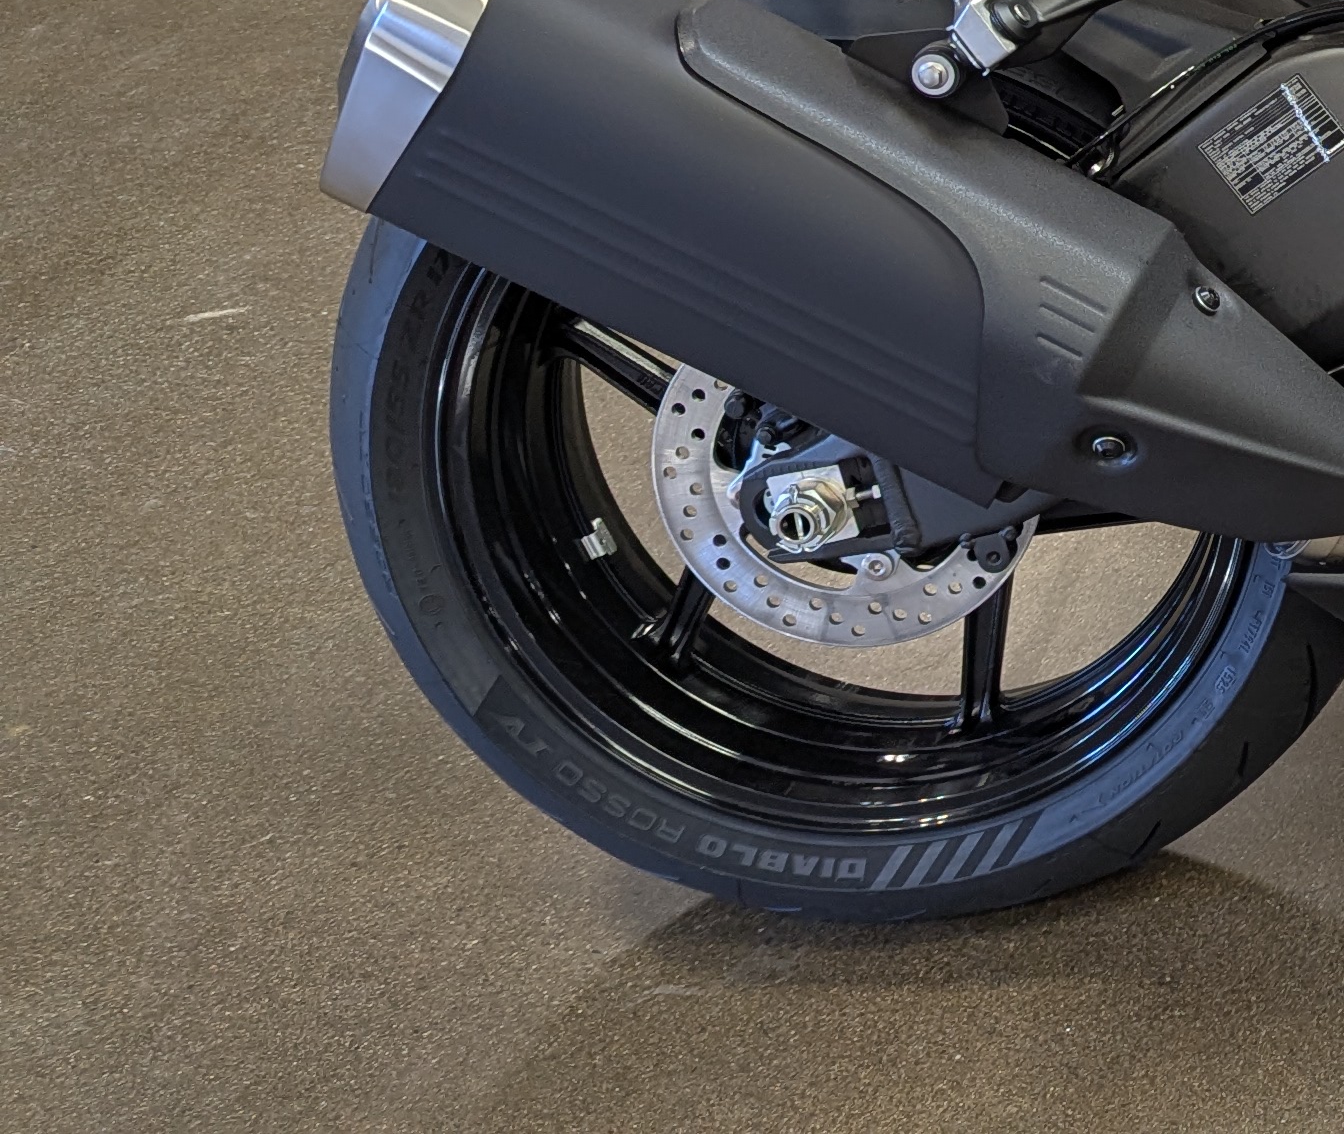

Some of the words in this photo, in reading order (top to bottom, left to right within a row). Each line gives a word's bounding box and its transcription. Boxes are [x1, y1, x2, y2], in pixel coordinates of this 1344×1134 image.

[499, 712, 553, 757] IV
[555, 761, 686, 844] ROSSO
[700, 832, 867, 883] DIABLO
